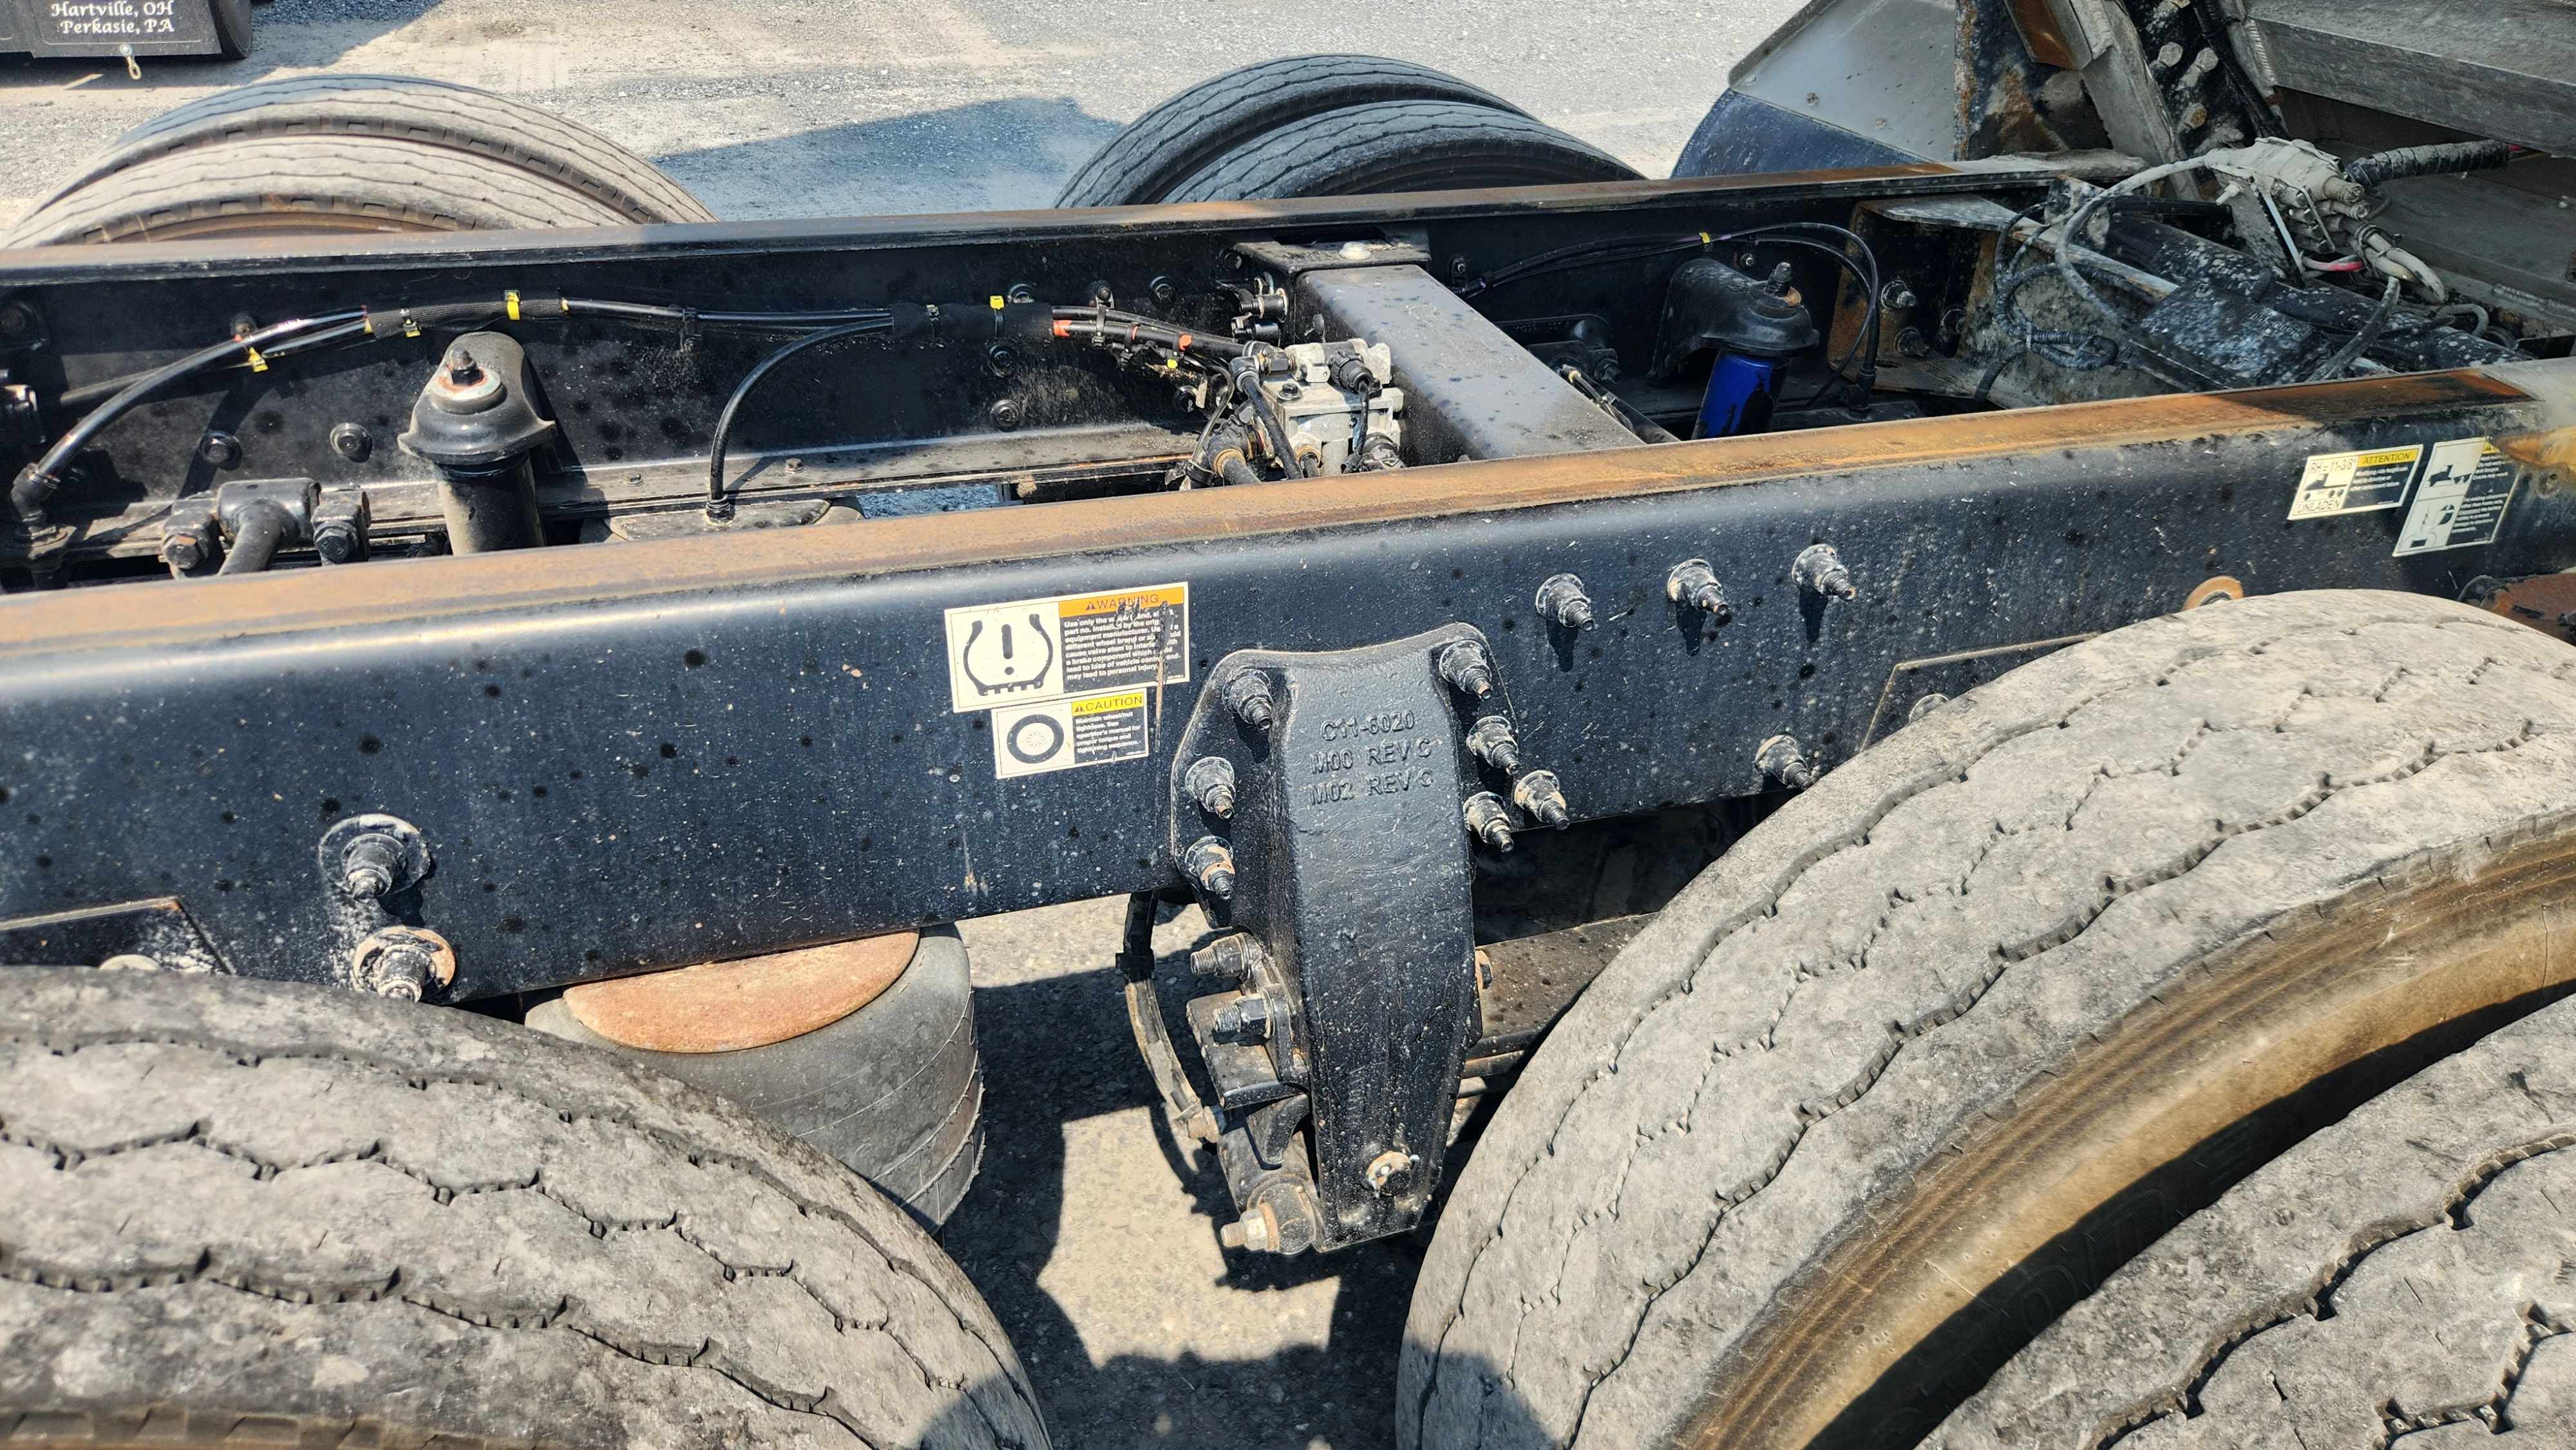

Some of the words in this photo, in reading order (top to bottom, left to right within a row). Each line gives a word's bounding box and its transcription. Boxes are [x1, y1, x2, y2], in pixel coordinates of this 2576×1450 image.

[51, 1, 138, 17] Hartville,
[143, 1, 175, 15] OH
[61, 18, 140, 35] Perkasie,
[144, 18, 175, 33] PA
[2362, 453, 2410, 464] ATTENTION
[2309, 461, 2322, 474] RH
[2298, 498, 2342, 513] UNLADEN
[1079, 618, 1094, 628] only
[1065, 628, 1079, 637] part
[1065, 634, 1102, 645] equipment
[1065, 641, 1094, 651] different
[1095, 639, 1116, 648] wheel
[1117, 636, 1137, 645] brand
[1088, 646, 1106, 655] valve
[1108, 645, 1124, 654] stem
[1072, 655, 1092, 665] brake
[1092, 652, 1132, 663] component
[1066, 664, 1081, 673] lead
[1067, 673, 1082, 681] may
[1083, 670, 1097, 679] lead
[1107, 664, 1137, 676] personal
[1086, 695, 1142, 711] CAUTION
[1321, 710, 1414, 741] C11-6020
[1309, 748, 1354, 775] M00
[1367, 739, 1412, 766] REV
[1417, 737, 1432, 758] C
[1307, 779, 1354, 805] M02
[1367, 770, 1412, 796] REV
[1417, 769, 1434, 787] C
